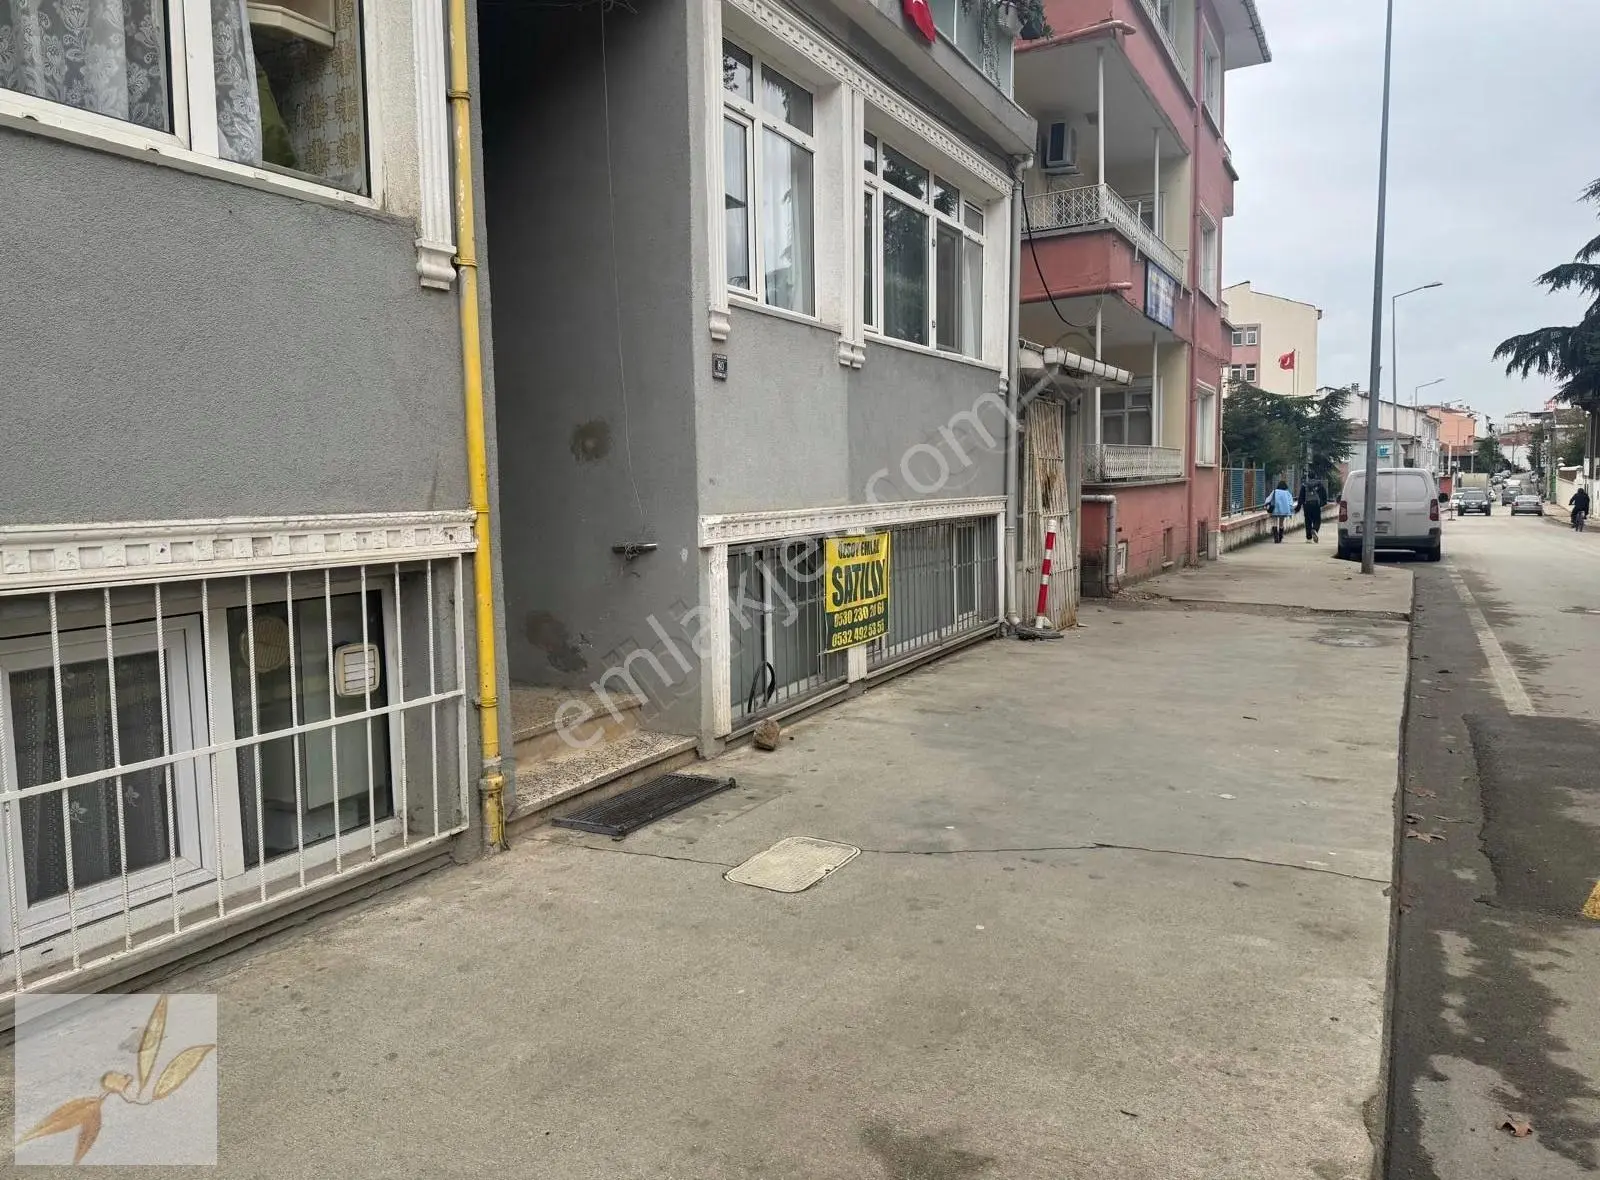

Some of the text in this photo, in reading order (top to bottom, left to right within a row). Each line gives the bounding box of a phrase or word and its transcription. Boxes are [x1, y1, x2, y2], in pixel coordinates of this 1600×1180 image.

[834, 611, 852, 628] 0530
[853, 607, 869, 622] 230
[831, 630, 853, 647] 0532
[853, 627, 868, 641] 492
